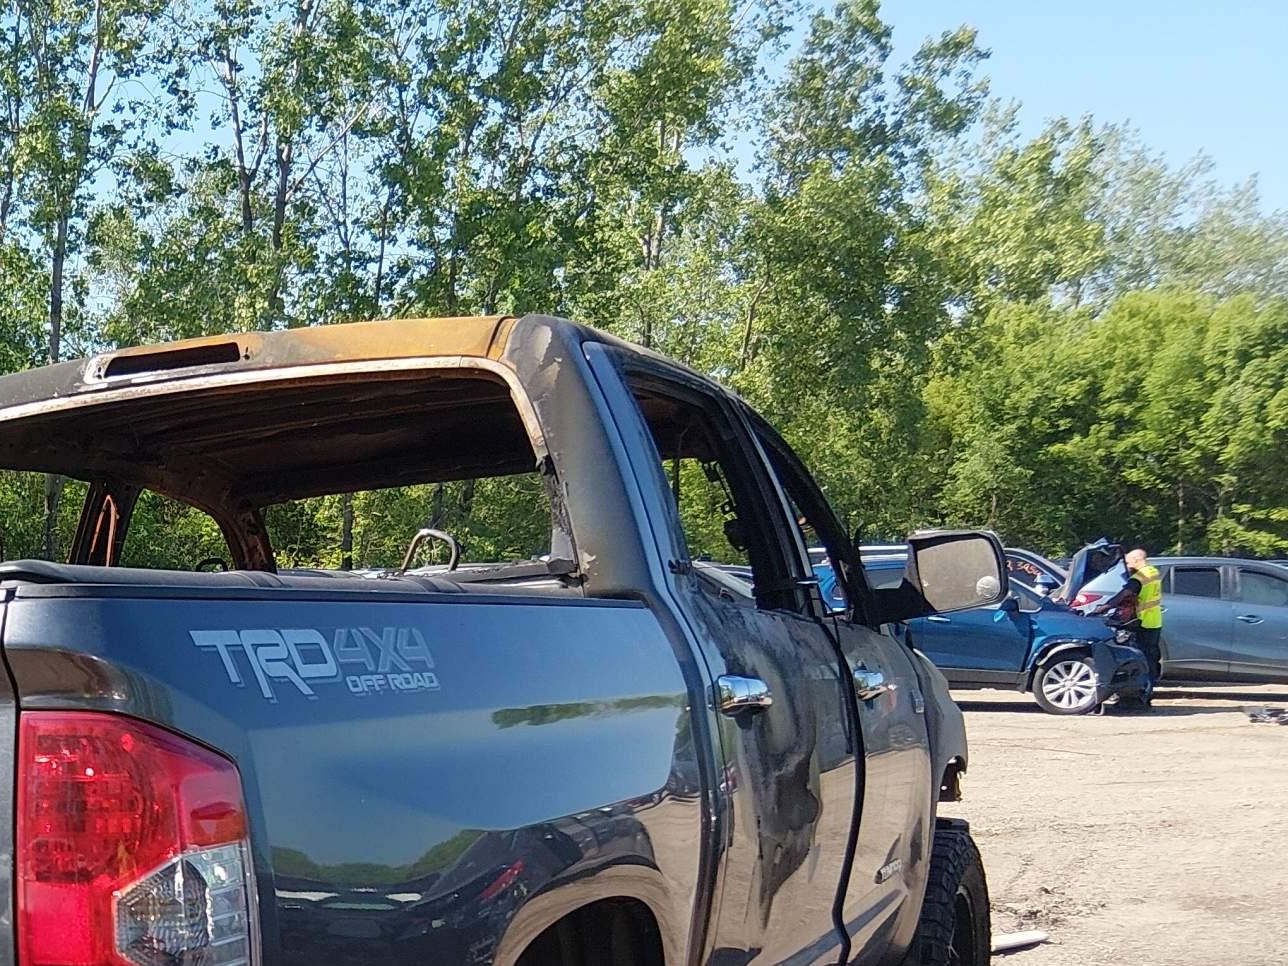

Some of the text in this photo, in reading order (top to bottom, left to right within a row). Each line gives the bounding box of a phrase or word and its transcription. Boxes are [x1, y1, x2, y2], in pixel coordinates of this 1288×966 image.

[189, 629, 341, 703] TRD
[345, 672, 440, 696] OFF ROAD
